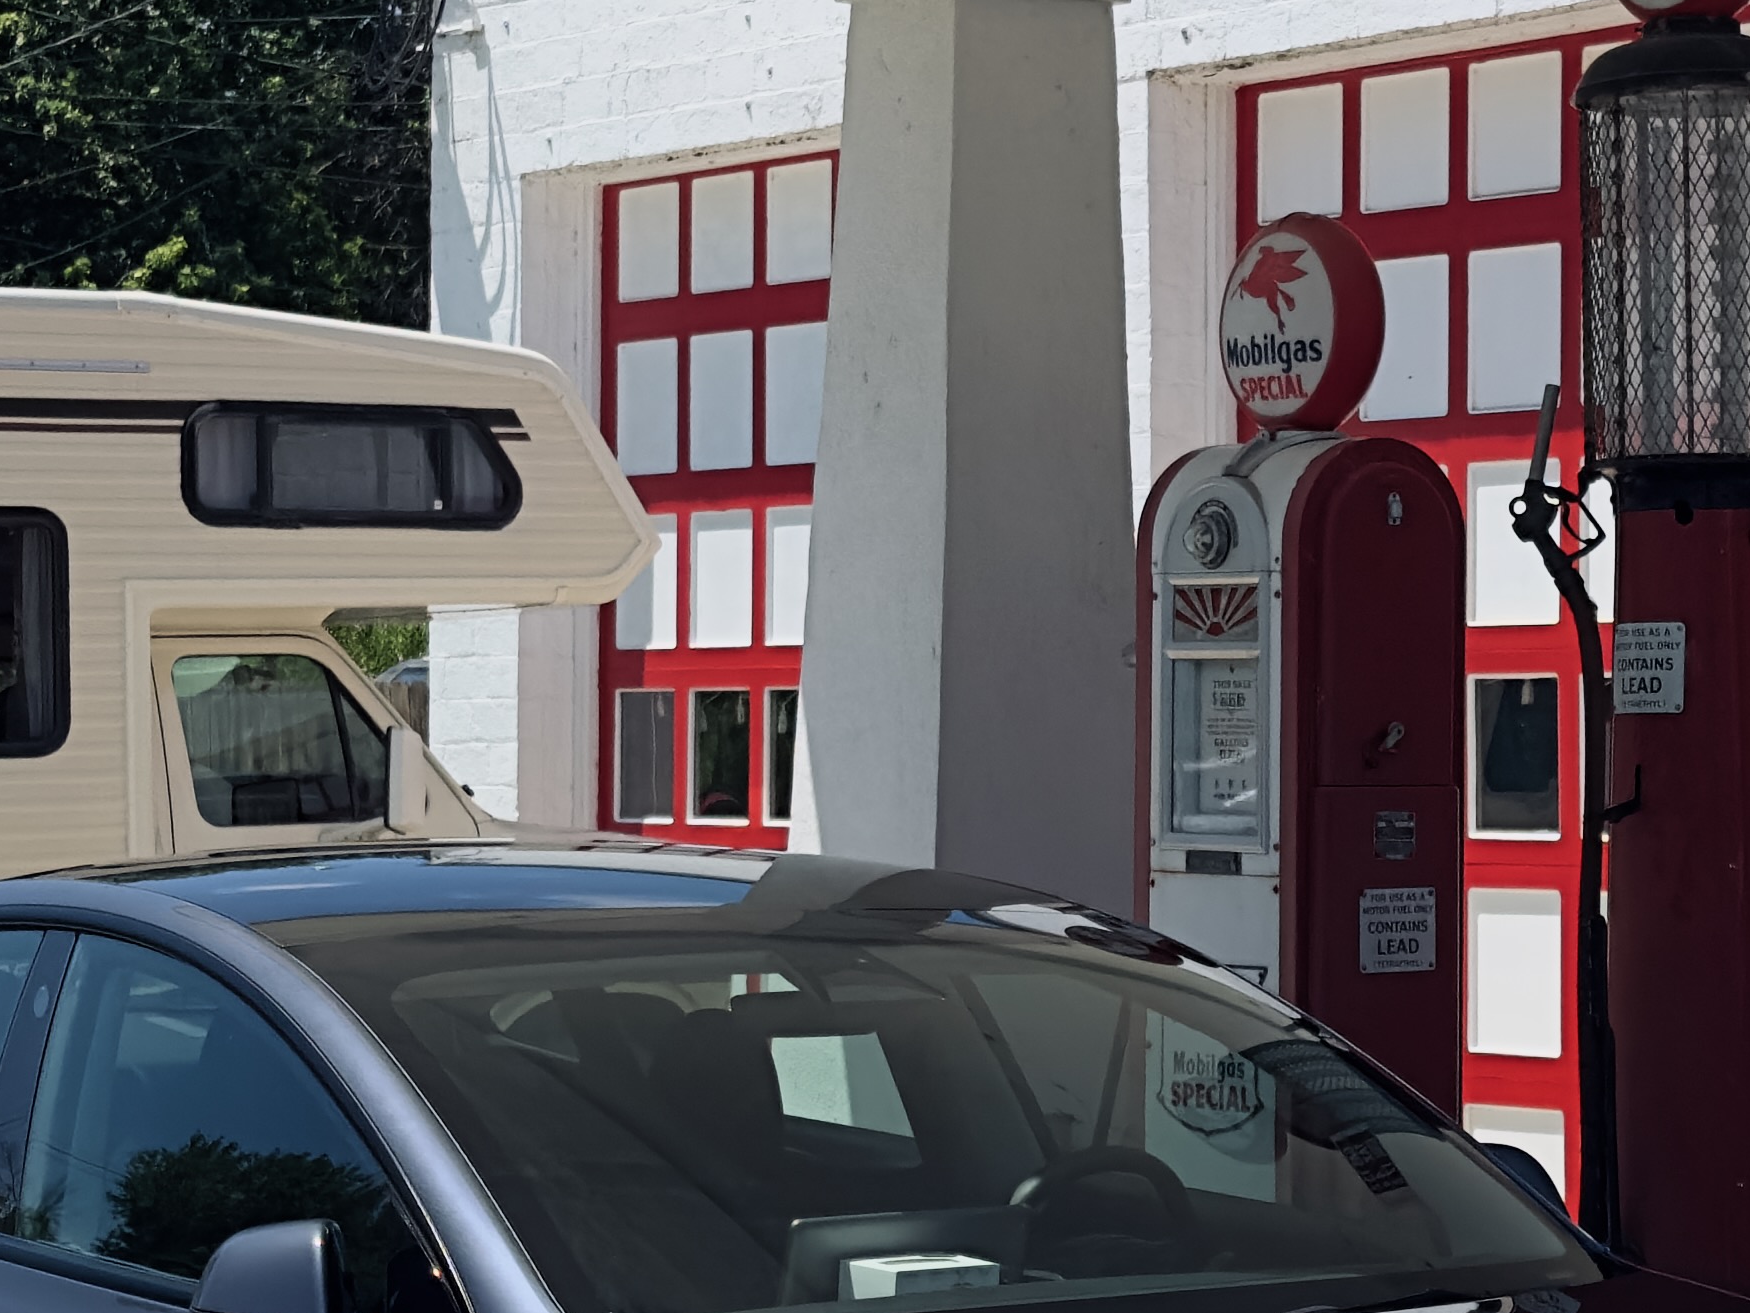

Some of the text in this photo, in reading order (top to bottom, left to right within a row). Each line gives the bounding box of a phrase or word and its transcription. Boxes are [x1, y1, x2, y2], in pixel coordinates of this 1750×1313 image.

[1226, 333, 1323, 374] Mobilgas
[1239, 374, 1309, 403] SPECIAL
[1617, 657, 1674, 672] CONTAINS
[1621, 676, 1662, 695] LEAD
[1368, 919, 1428, 935] CONTAINS
[1377, 938, 1420, 955] LEAD
[1172, 1050, 1246, 1084] Mobilgas
[1169, 1080, 1251, 1113] SPECIAL
